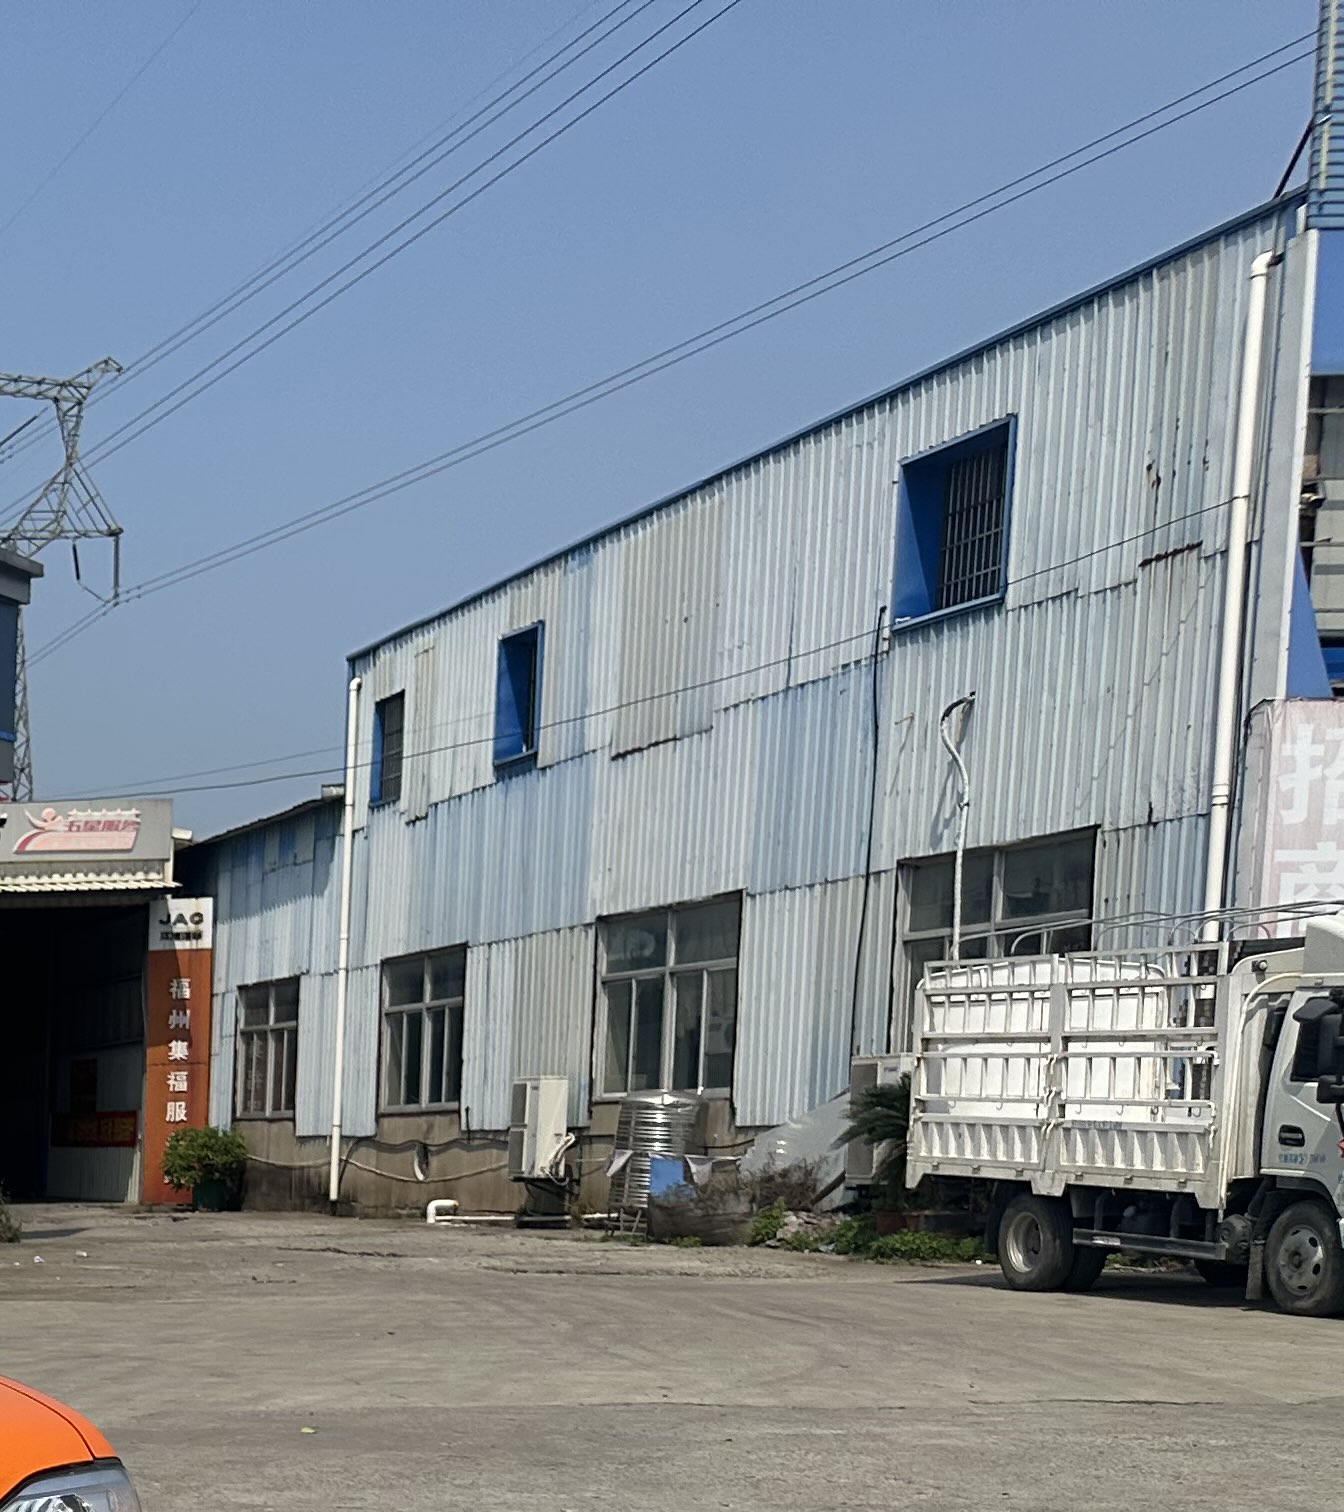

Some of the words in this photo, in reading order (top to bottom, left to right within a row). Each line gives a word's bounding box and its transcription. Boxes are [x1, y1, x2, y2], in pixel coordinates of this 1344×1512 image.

[165, 978, 192, 1147] 福州集福服
